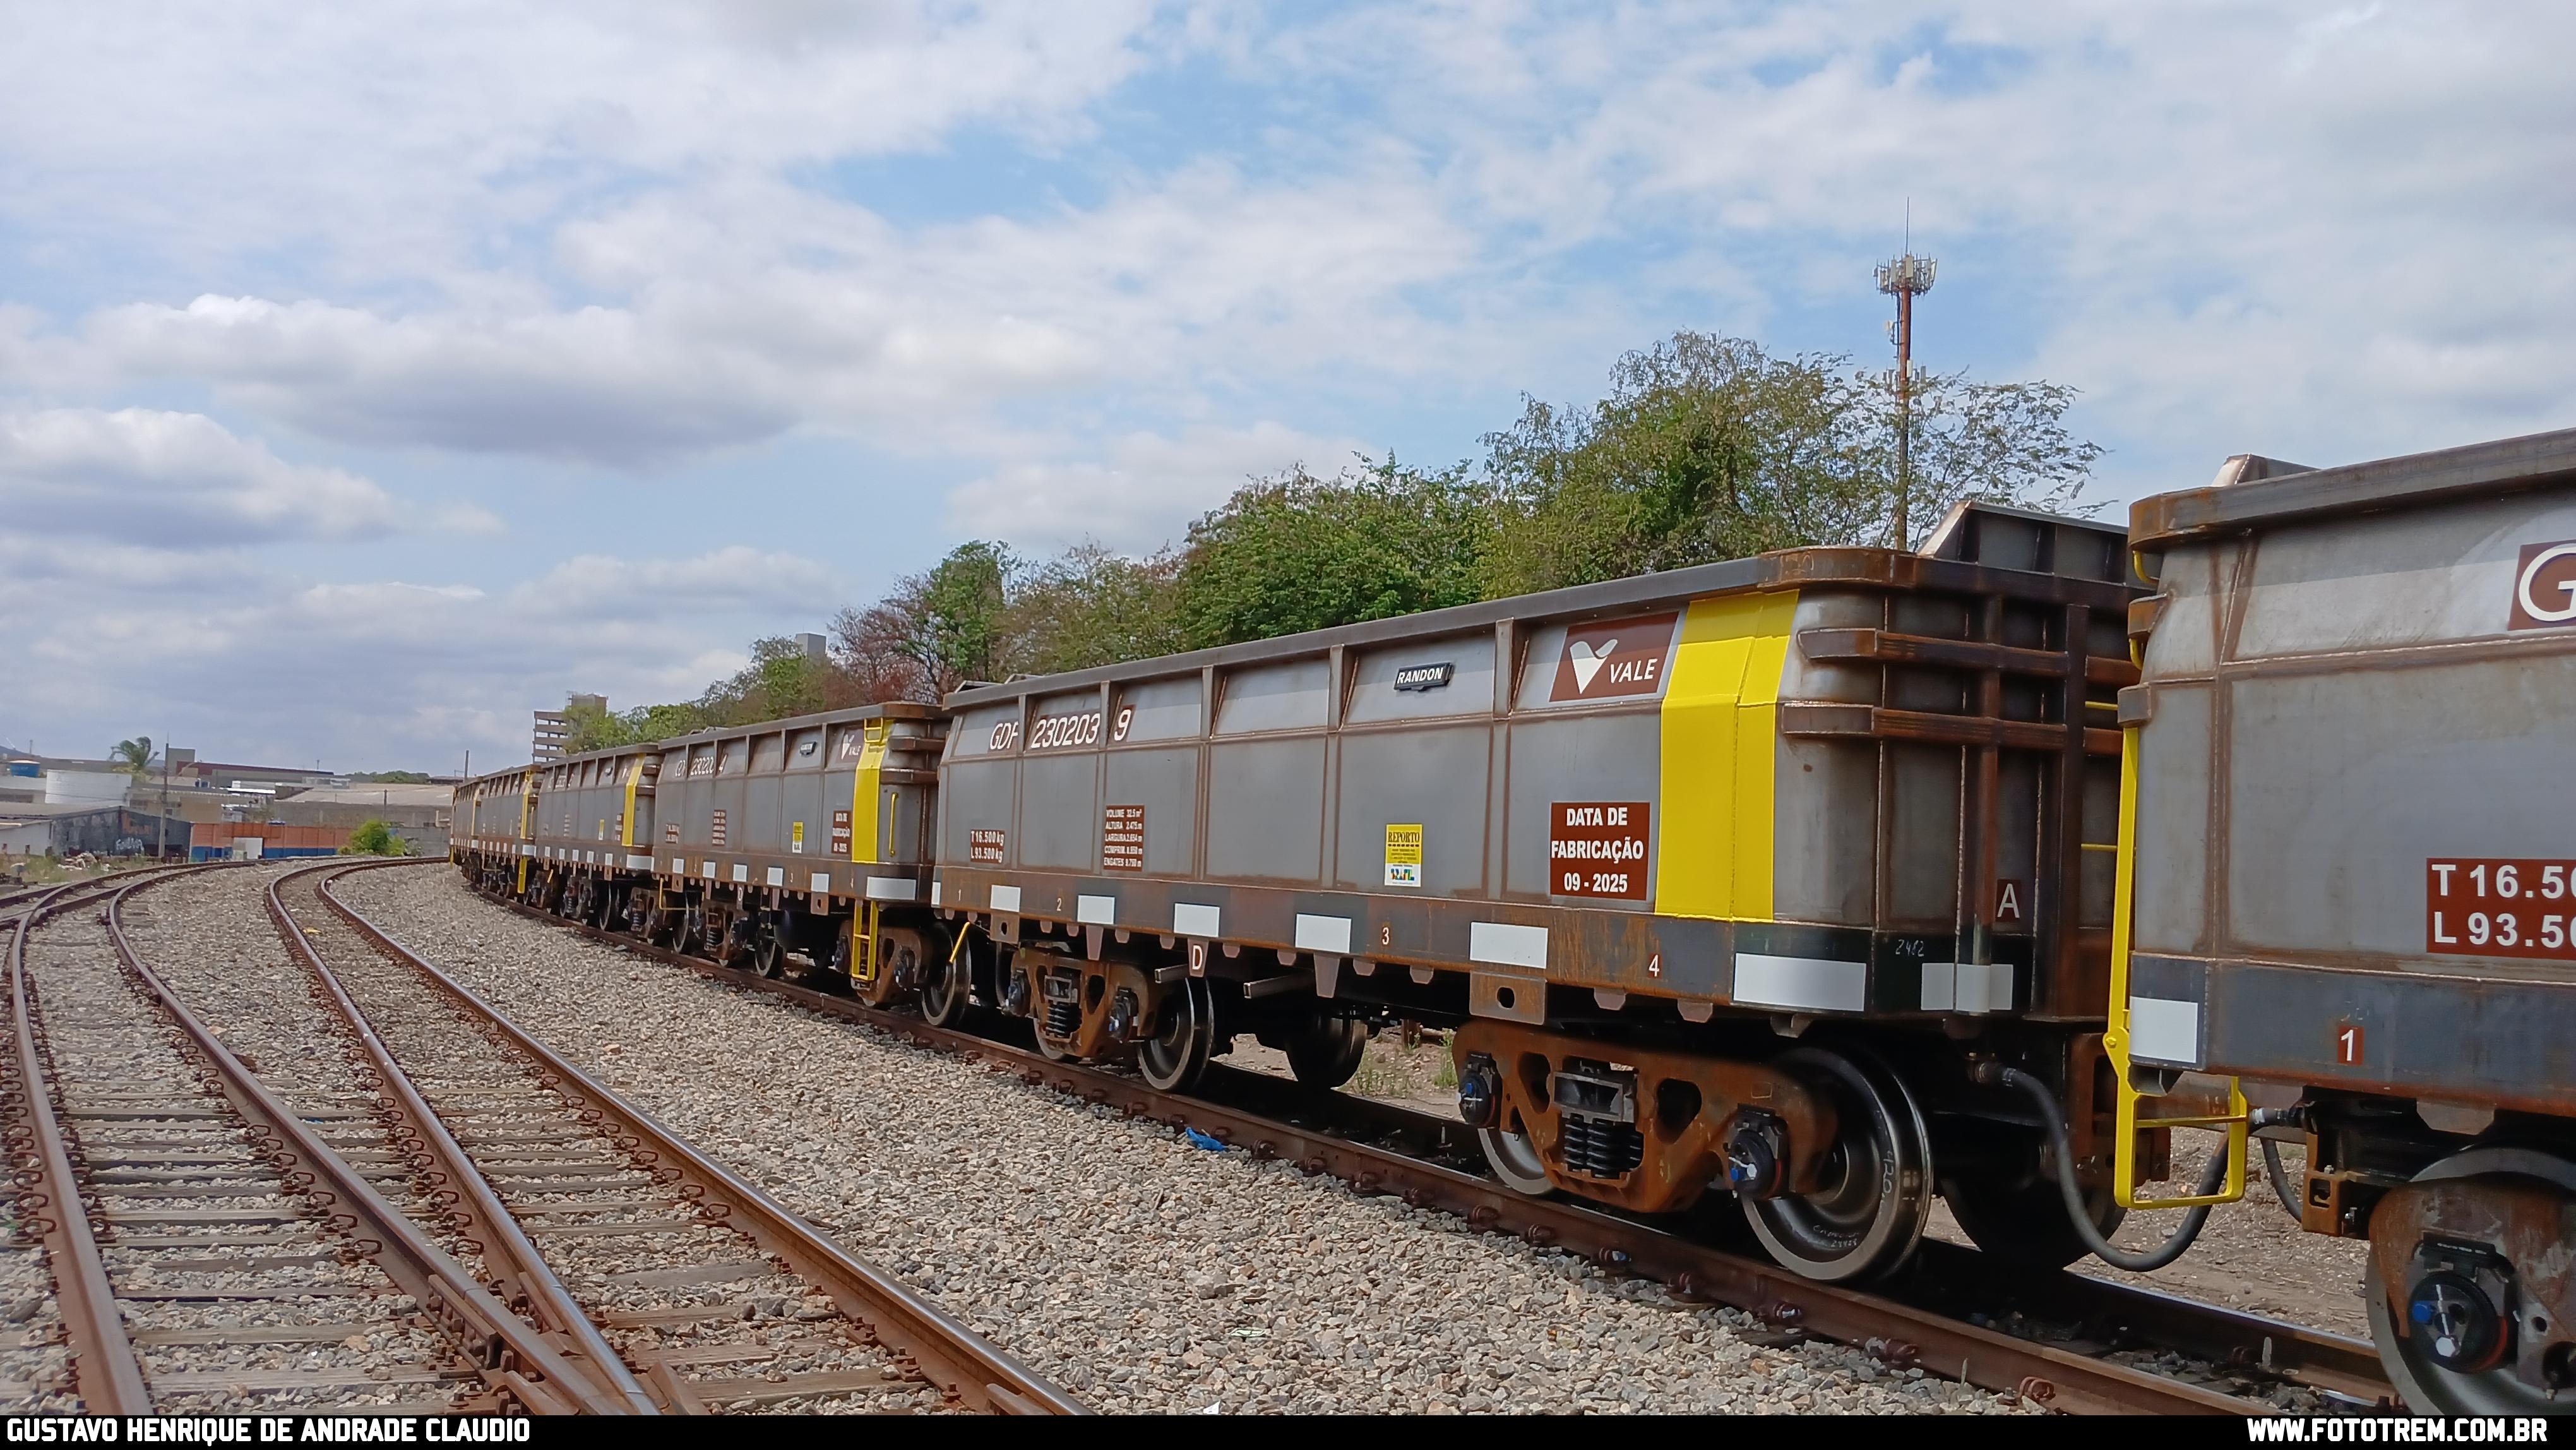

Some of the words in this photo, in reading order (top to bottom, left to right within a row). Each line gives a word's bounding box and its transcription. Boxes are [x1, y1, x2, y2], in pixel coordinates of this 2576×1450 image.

[2519, 543, 2576, 621] G
[1397, 667, 1443, 684] RANDON
[1610, 659, 1657, 683] VALE
[1031, 713, 1100, 748] 230203
[1114, 709, 1131, 741] 9
[1566, 808, 1603, 826] DATA
[1607, 807, 1628, 826] DE
[970, 830, 975, 842] T
[975, 830, 996, 844] 16.500
[996, 831, 1005, 846] kg
[1388, 831, 1420, 843] REPORTO
[970, 847, 975, 859] L
[974, 847, 995, 860] 93.500
[995, 848, 1003, 863] kg
[1551, 836, 1644, 864] FABRICAÇÃO
[1564, 872, 1580, 891] 09
[1592, 873, 1628, 892] 2025
[2431, 864, 2456, 896] T
[2469, 865, 2576, 899] 16.5
[1056, 897, 1062, 911] 2
[1997, 884, 2020, 918] A
[1381, 928, 1389, 945] 3
[2434, 911, 2457, 944] L
[2467, 912, 2576, 949] 93.5
[1192, 945, 1203, 970] D
[1649, 955, 1660, 976] 4
[2340, 1029, 2354, 1062] 1
